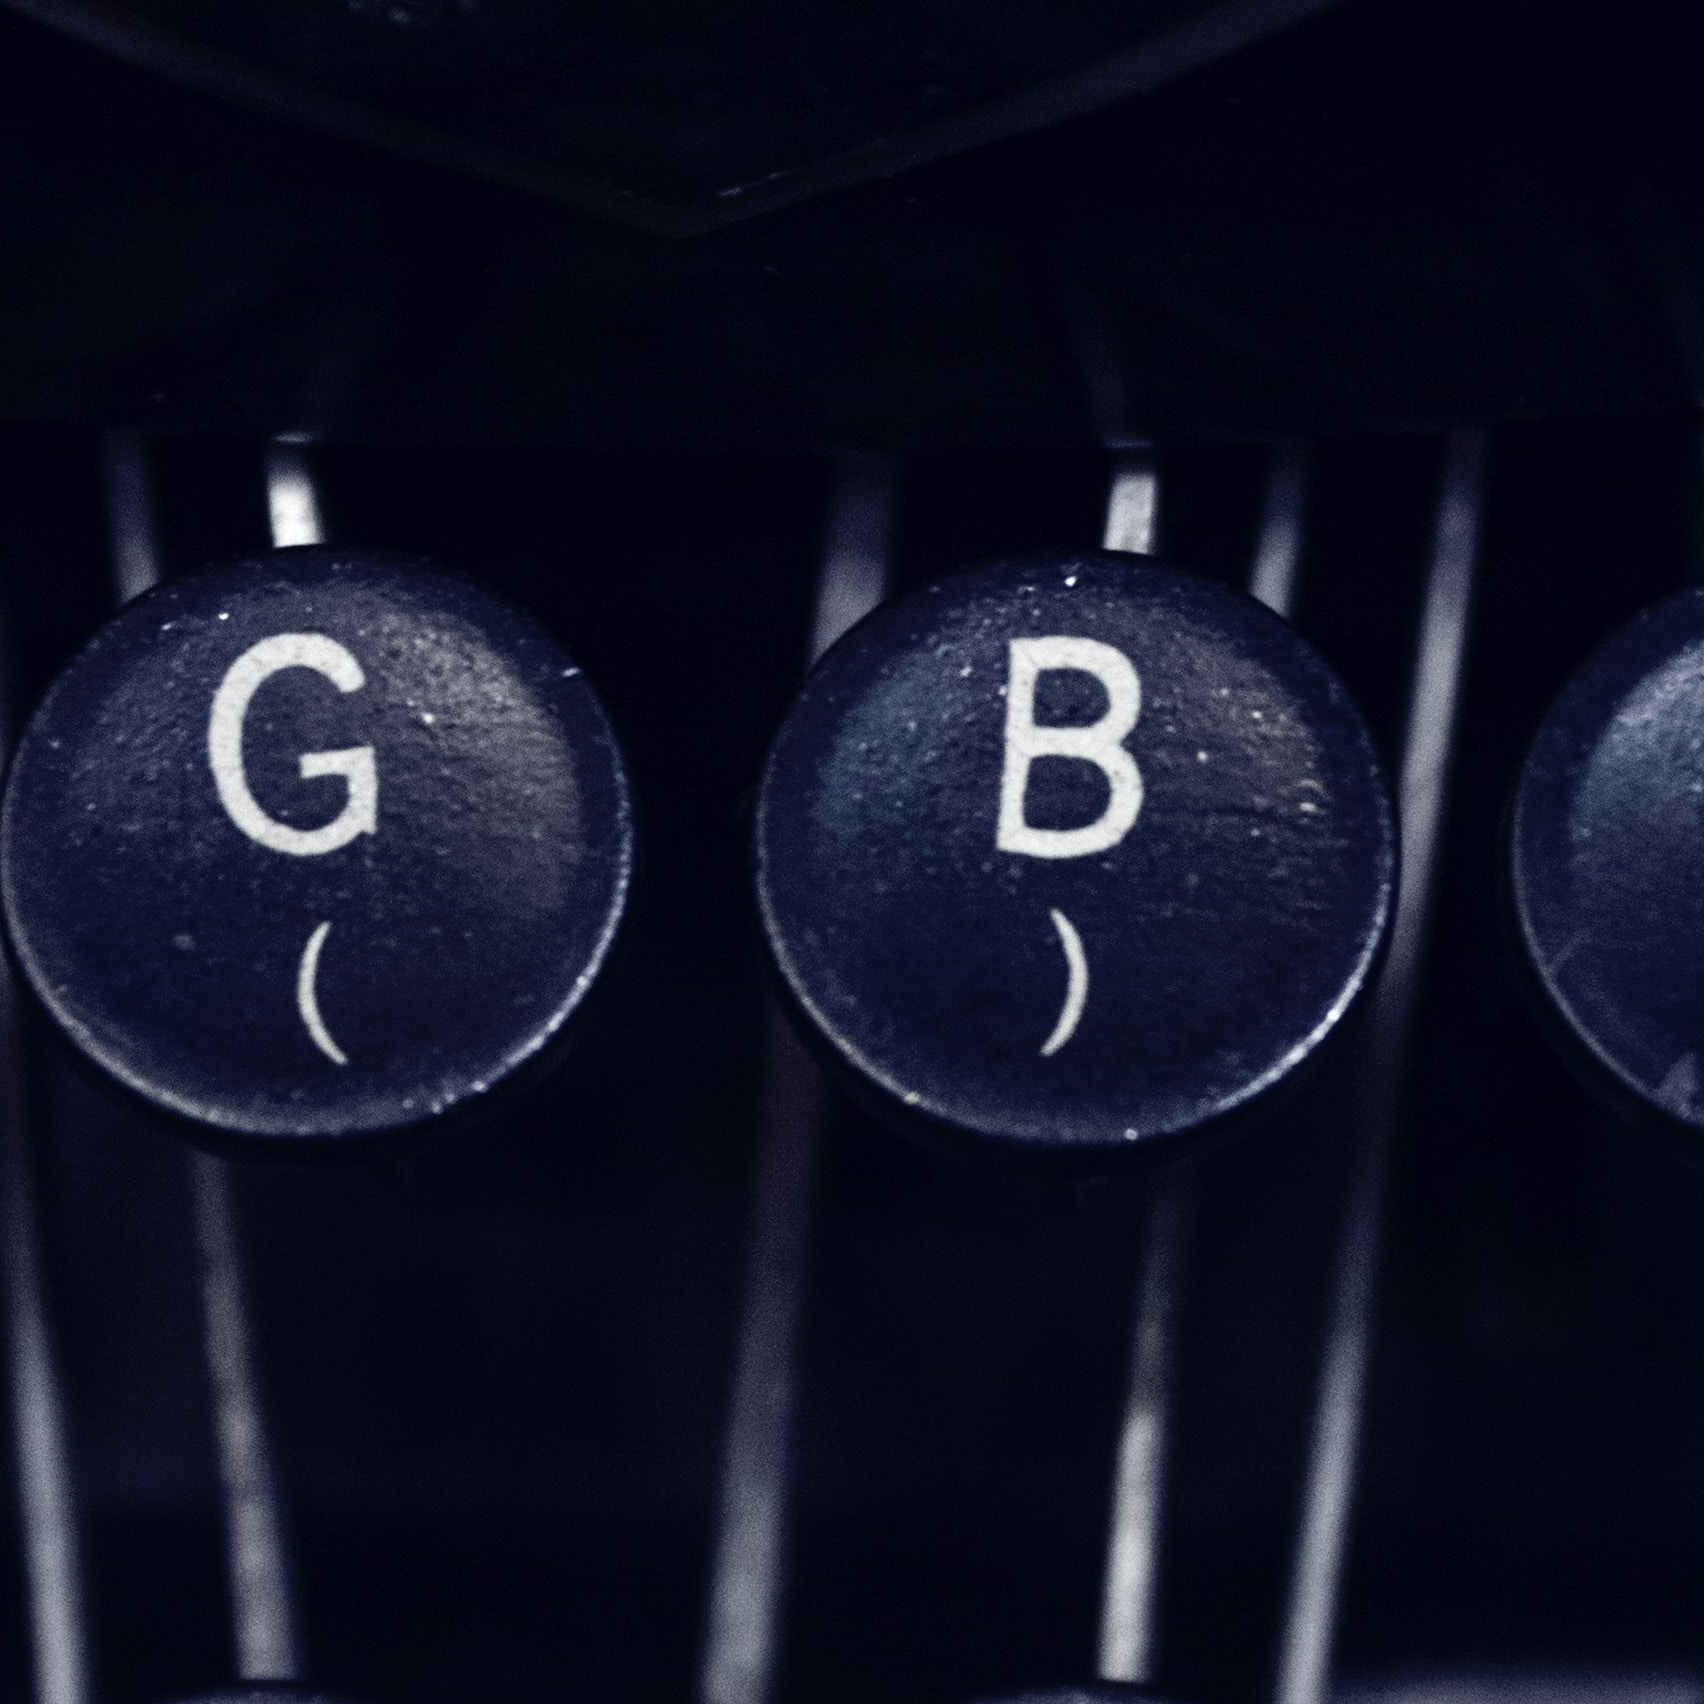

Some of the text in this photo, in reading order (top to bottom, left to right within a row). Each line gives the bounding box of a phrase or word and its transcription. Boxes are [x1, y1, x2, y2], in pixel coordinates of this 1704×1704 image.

[205, 629, 381, 857] G
[994, 635, 1143, 859] B
[297, 920, 349, 1066] (
[1039, 908, 1090, 1058] )
